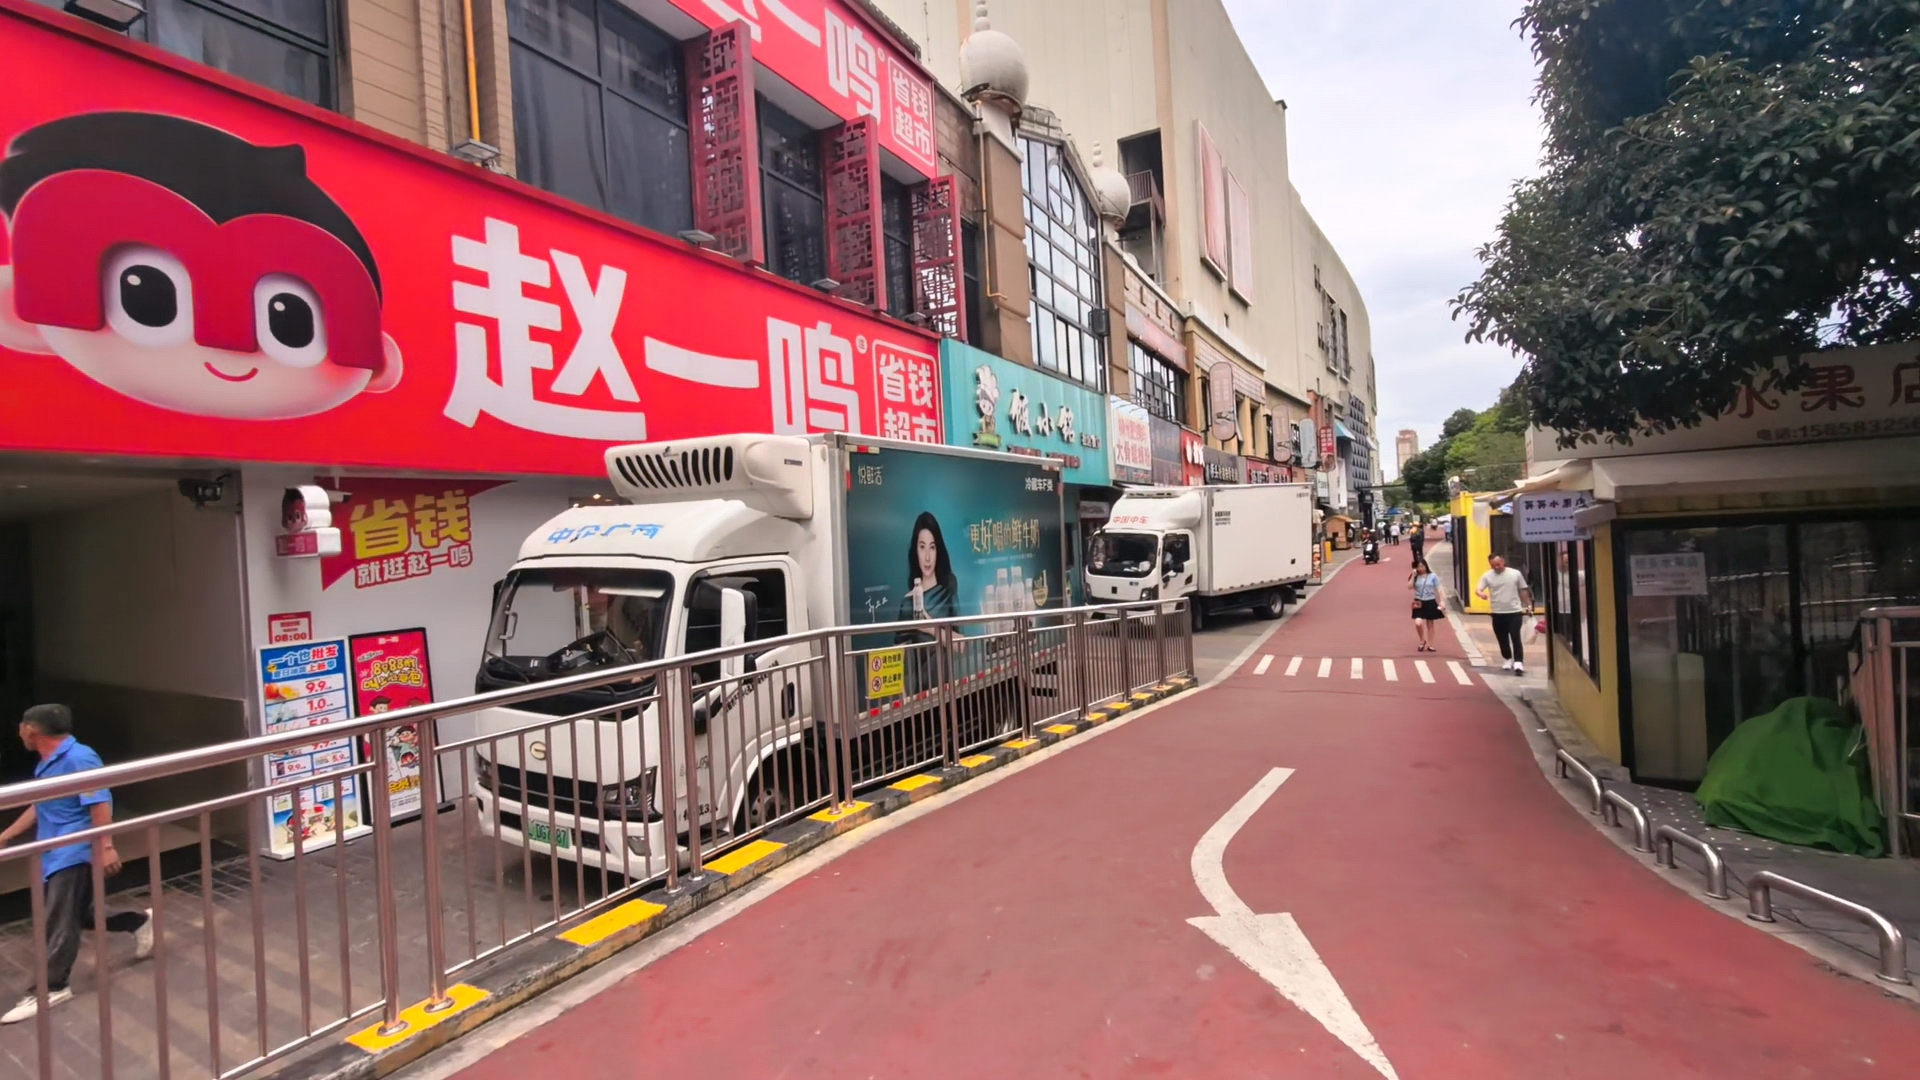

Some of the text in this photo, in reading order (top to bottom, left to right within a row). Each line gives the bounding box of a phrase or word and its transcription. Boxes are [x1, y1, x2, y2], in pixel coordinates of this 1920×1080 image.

[892, 67, 930, 123] 省钱
[895, 106, 932, 156] 超市
[443, 216, 860, 441] 赵一鸣
[879, 351, 934, 410] 省钱
[882, 406, 937, 444] 超市
[350, 489, 471, 560] 省钱
[969, 516, 1041, 554] 更好喝的鲜牛奶
[1112, 515, 1149, 525] 中国中车
[356, 545, 472, 586] 就逛赵一鸣
[268, 645, 339, 666] 一个也批发
[274, 632, 307, 642] 08:00
[305, 680, 327, 693] 9.9
[306, 698, 327, 711] 1.0
